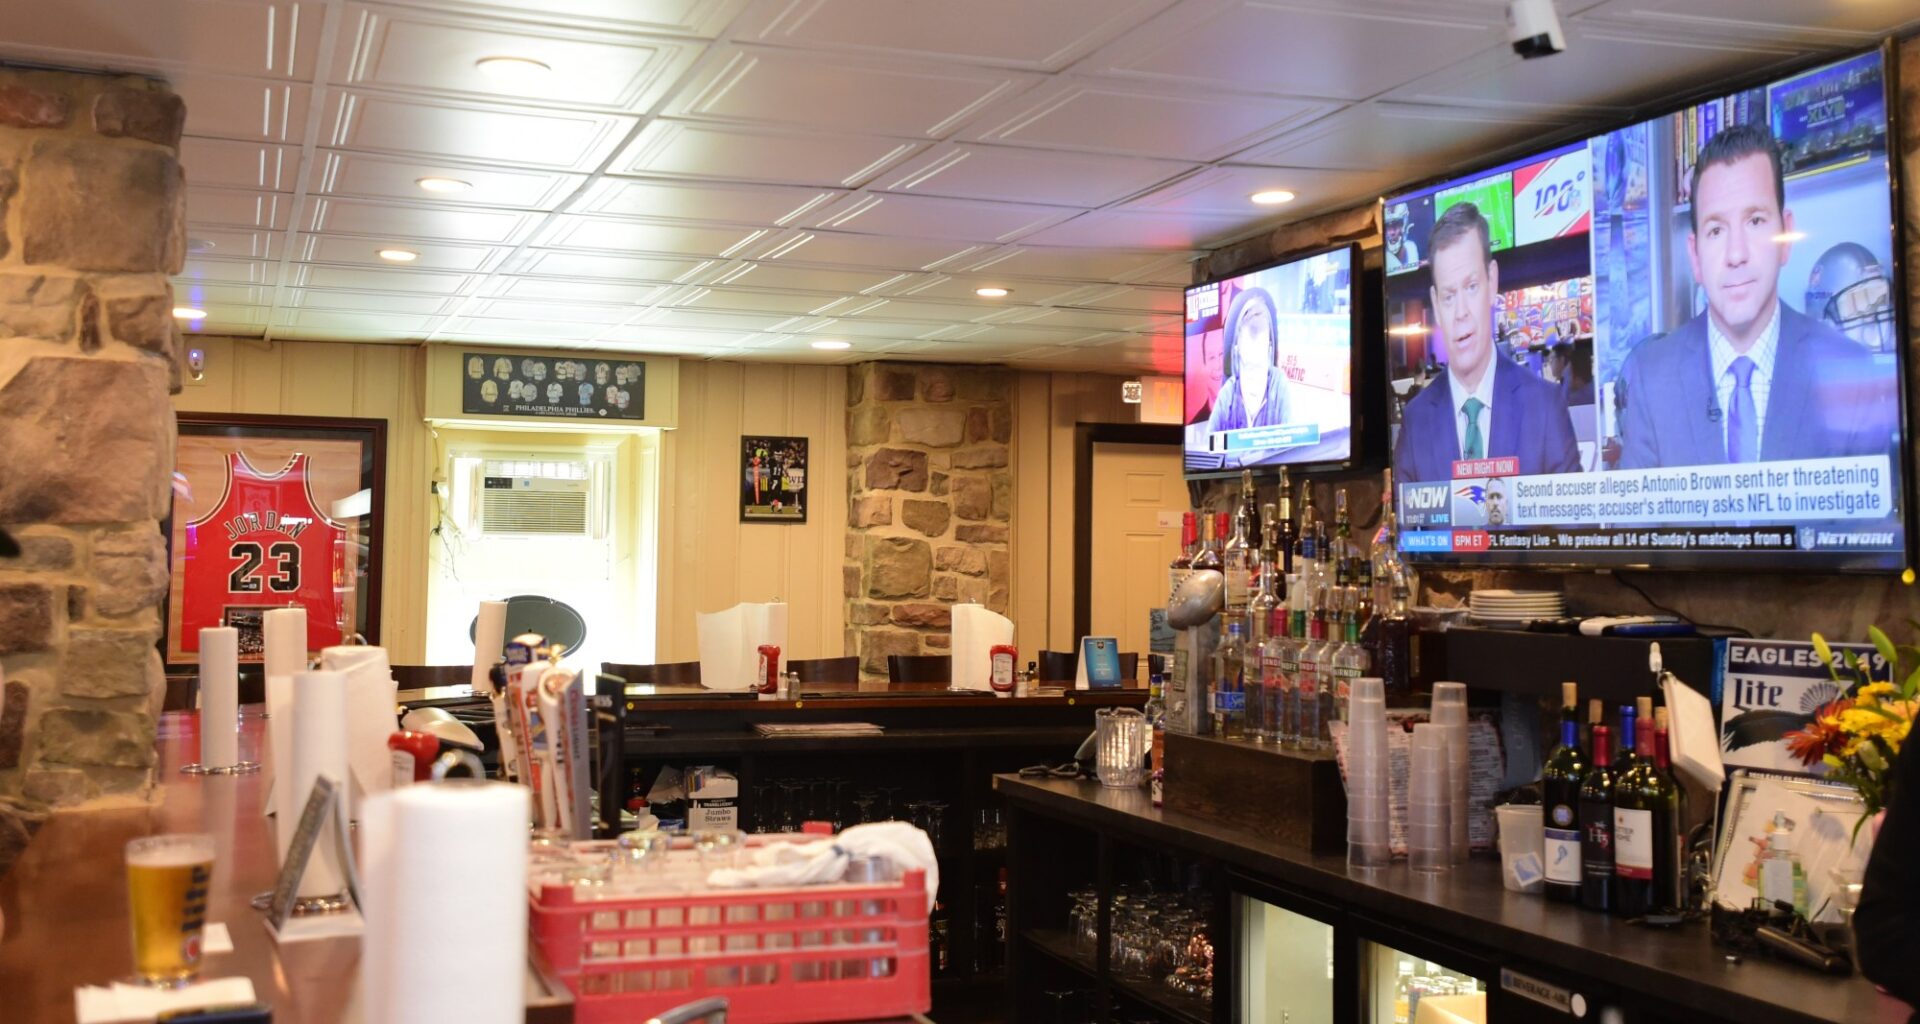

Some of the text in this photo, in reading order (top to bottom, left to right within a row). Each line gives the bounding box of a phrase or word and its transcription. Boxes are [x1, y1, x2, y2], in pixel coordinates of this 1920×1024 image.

[515, 404, 564, 412] PHILADELPHIA
[1457, 460, 1514, 475] NEW RIGHT NOW
[1517, 464, 1879, 498] Second accuser alleges Antonio Brown sent her threatening
[1408, 486, 1449, 509] NOW
[1517, 490, 1880, 521] text messages; accuser's attorney asks NFL to investigate
[224, 510, 307, 541] JORDAN
[1431, 513, 1449, 524] LIVE
[1408, 535, 1449, 547] WHAT'S ON
[1455, 534, 1483, 547] 6PM ET
[1499, 534, 1531, 549] Fantasy
[1532, 534, 1550, 546] Live
[1558, 533, 1572, 546] We
[1574, 533, 1611, 548] preview
[1613, 533, 1624, 545] all
[1625, 533, 1638, 545] 14
[1639, 533, 1649, 545] of
[1651, 532, 1696, 548] Sunday's
[1698, 532, 1751, 548] matchups
[1753, 532, 1782, 546] from
[1783, 534, 1793, 545] a
[1817, 531, 1895, 545] NETWORK
[228, 541, 302, 594] 23
[1730, 646, 1819, 668] EAGLES
[1733, 677, 1784, 709] Lite
